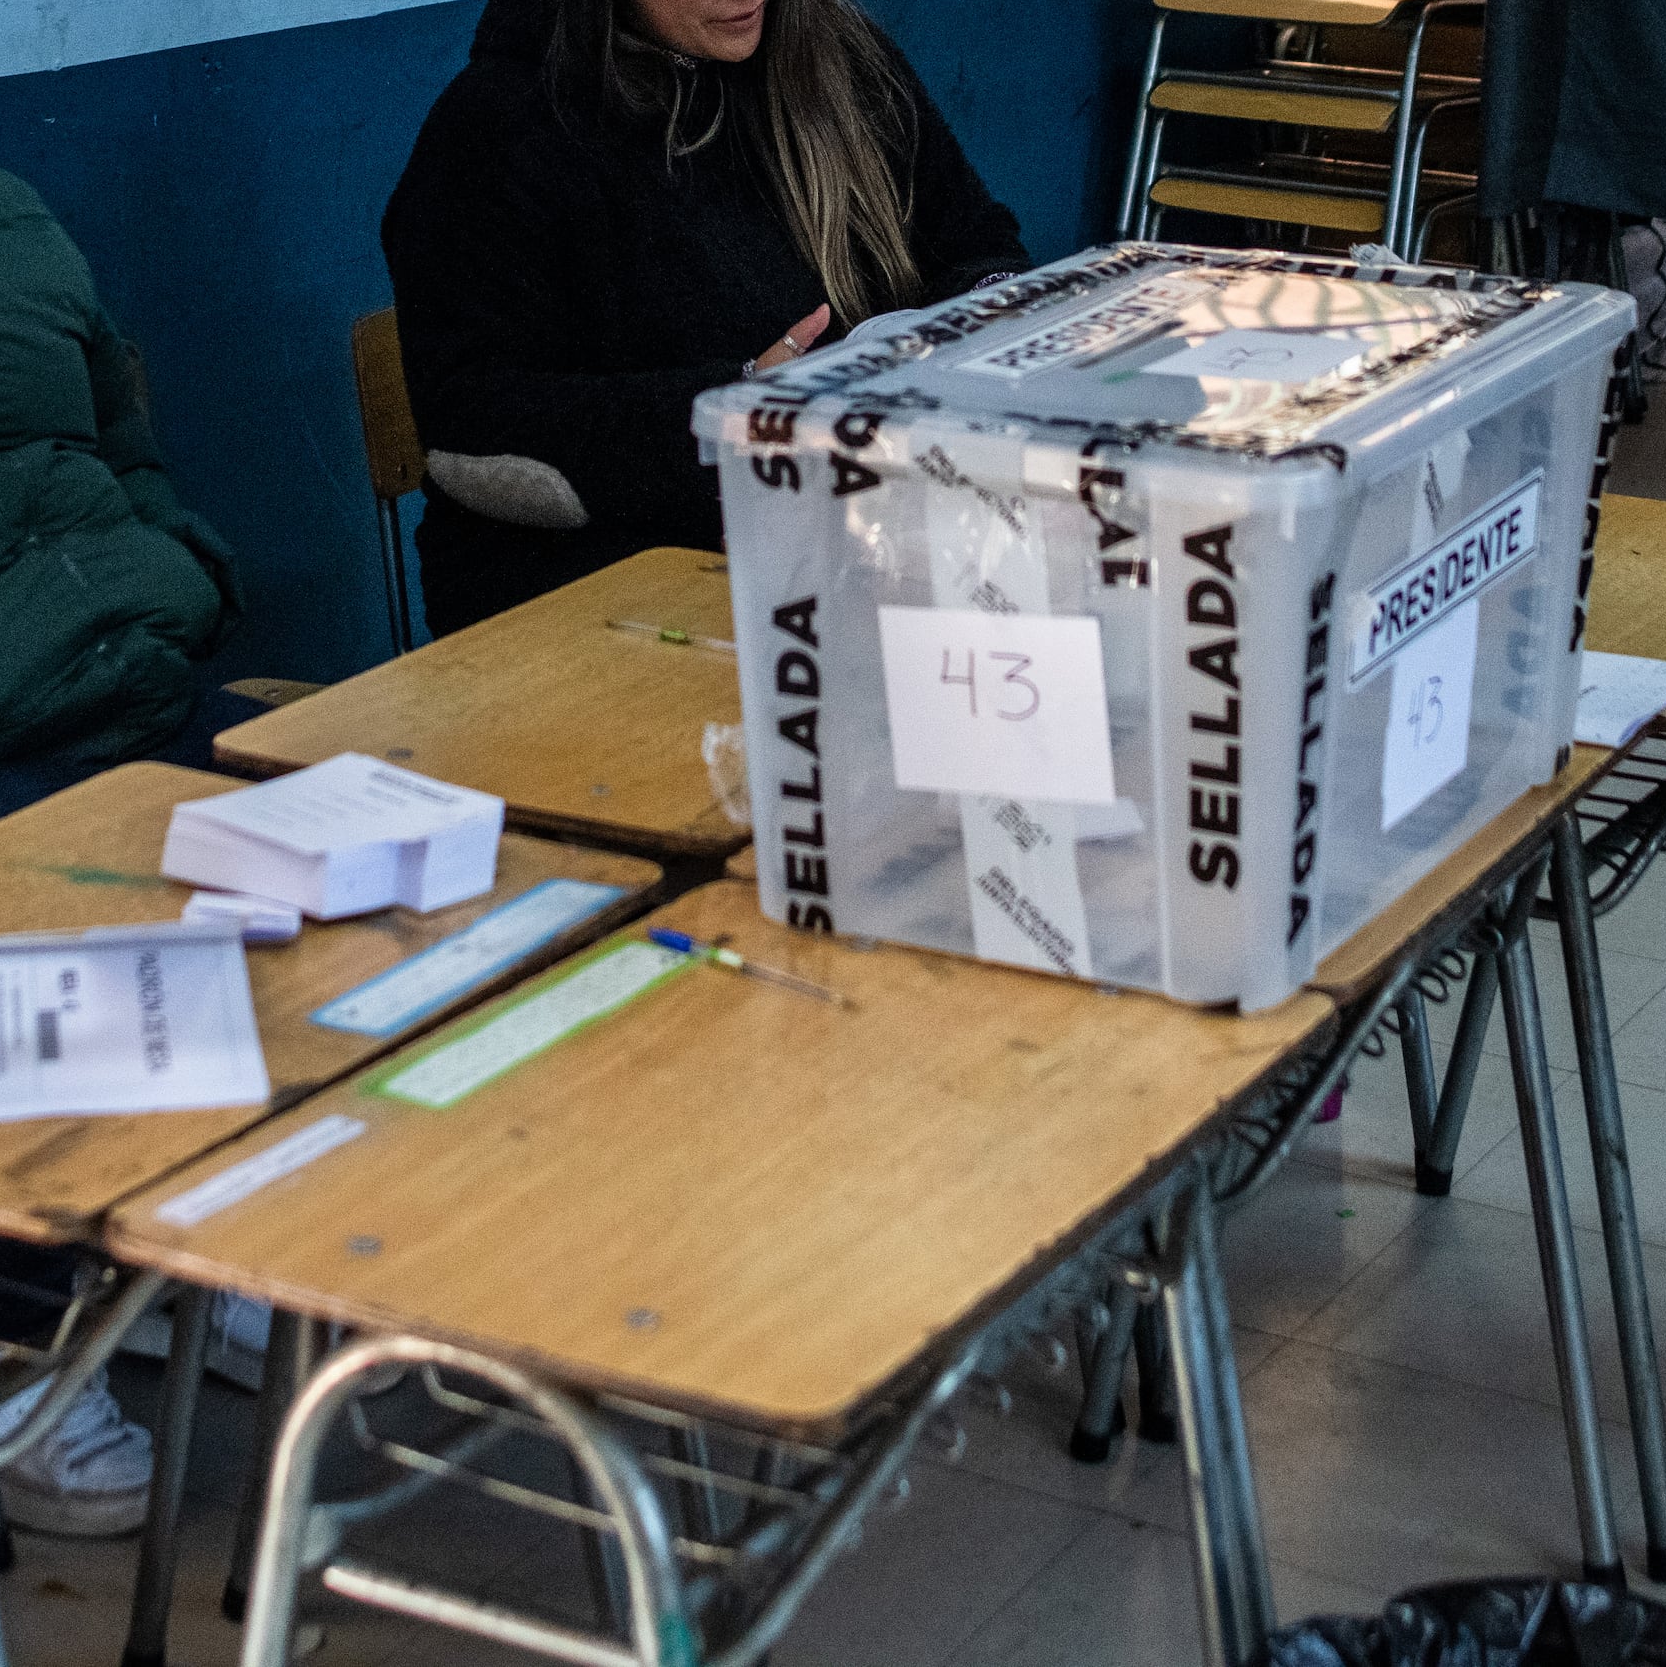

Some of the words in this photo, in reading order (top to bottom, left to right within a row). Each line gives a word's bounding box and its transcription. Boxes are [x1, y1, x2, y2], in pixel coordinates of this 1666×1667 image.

[987, 282, 1188, 368] PRESIDENTE
[1369, 506, 1523, 656] PRESIDENTE
[940, 647, 1040, 721] 43
[1182, 525, 1241, 890] SELLADA
[1286, 570, 1337, 948] SELLADA
[1407, 675, 1444, 751] 43
[771, 594, 833, 935] SELLADA
